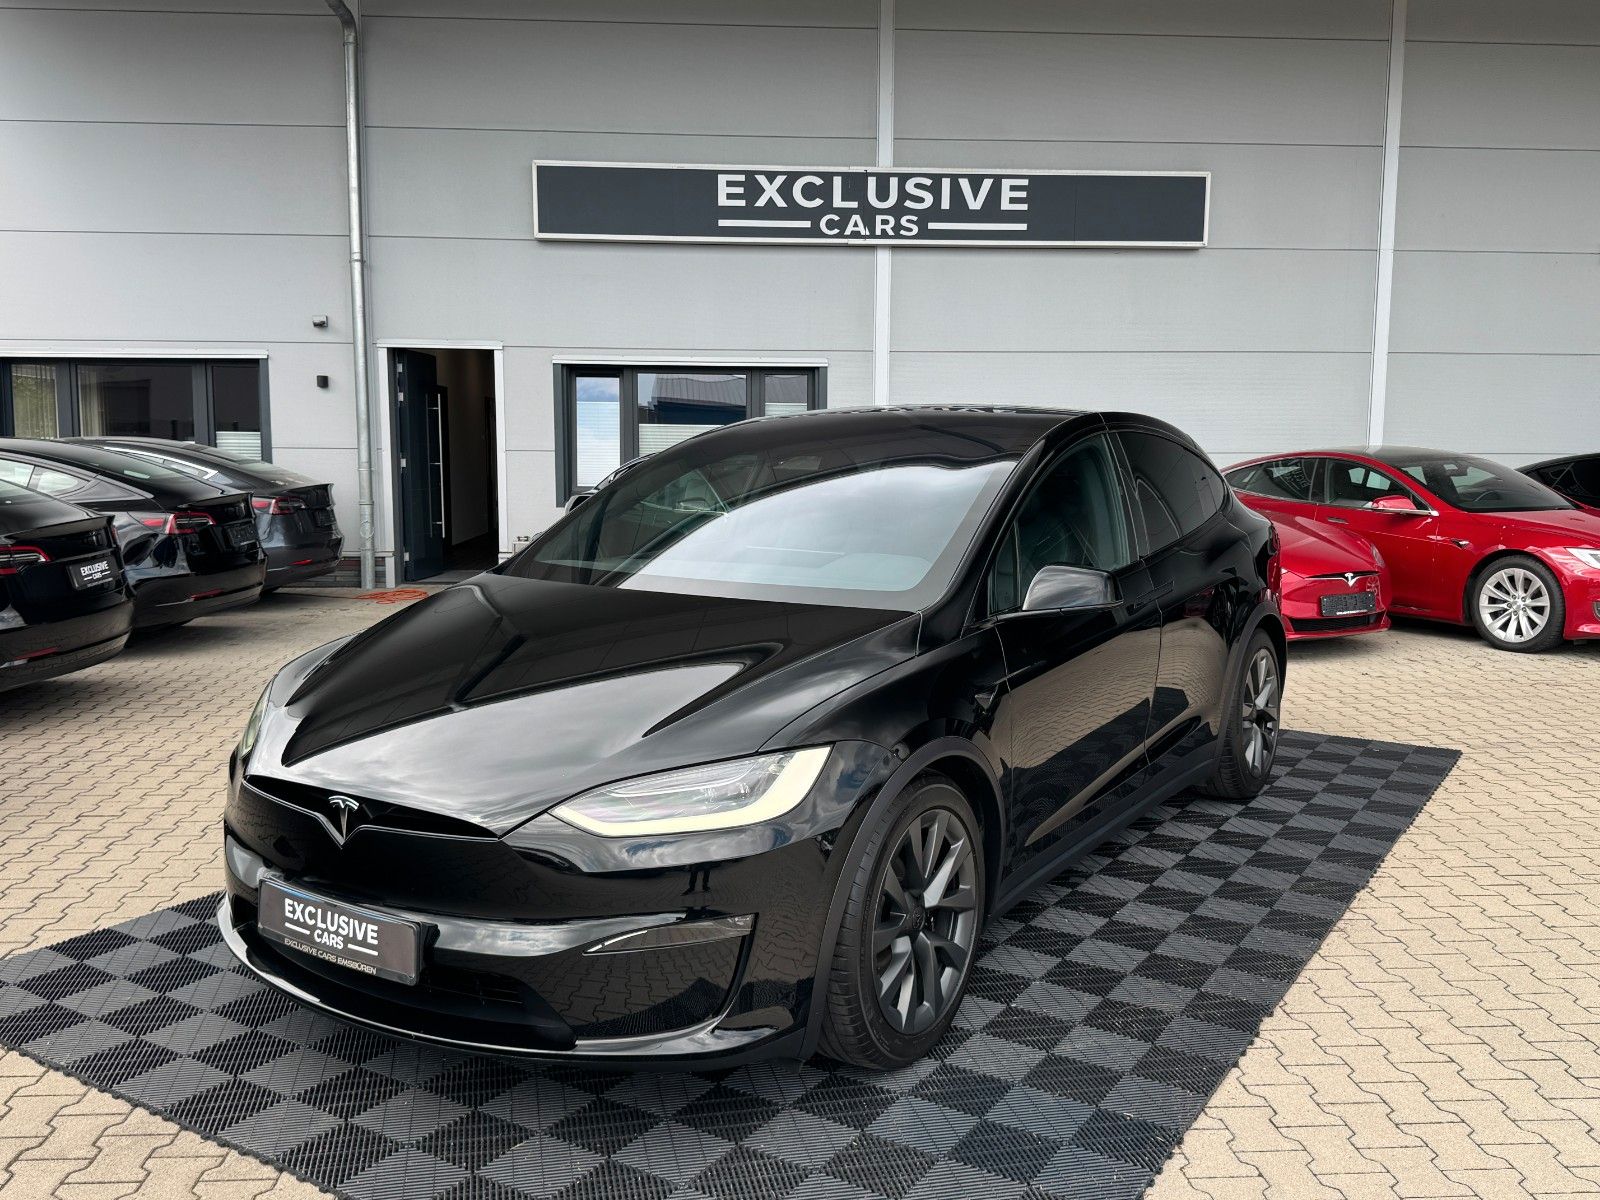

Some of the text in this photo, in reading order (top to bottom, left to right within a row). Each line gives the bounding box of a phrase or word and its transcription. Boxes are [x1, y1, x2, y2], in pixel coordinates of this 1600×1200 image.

[717, 174, 1029, 211] EXCLUSIVE
[819, 214, 919, 236] CARS
[284, 897, 379, 945] EXCLUSIVE
[314, 929, 344, 950] CARS
[284, 938, 377, 975] EXCLUSIVE CARS EMSBÜREN
